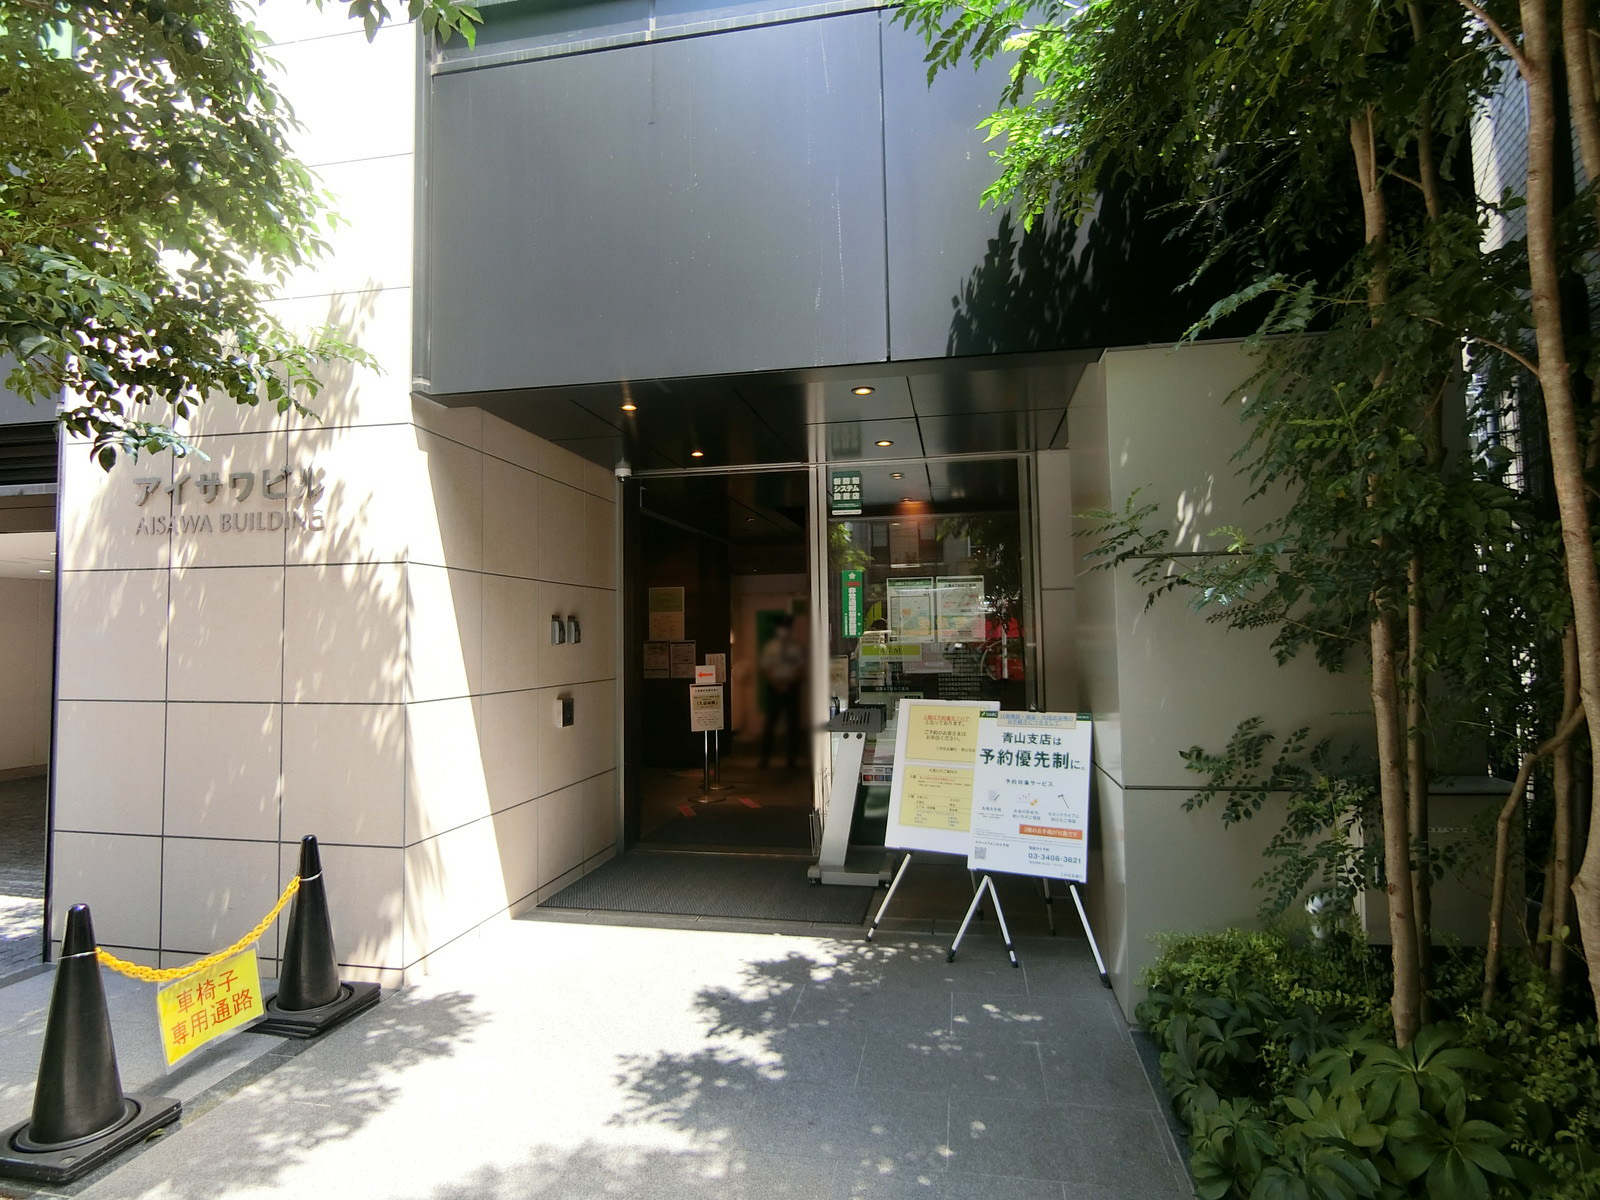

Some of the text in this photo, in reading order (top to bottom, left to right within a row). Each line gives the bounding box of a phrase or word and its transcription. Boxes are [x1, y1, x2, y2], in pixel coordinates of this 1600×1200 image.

[133, 465, 326, 507] アイサワビル
[136, 510, 325, 536] AISAWA BUILDING
[1002, 732, 1062, 746] 青山支店は
[980, 748, 1085, 771] 予約優先制に。
[176, 969, 238, 1014] 車椅子
[171, 988, 253, 1045] 専用通路
